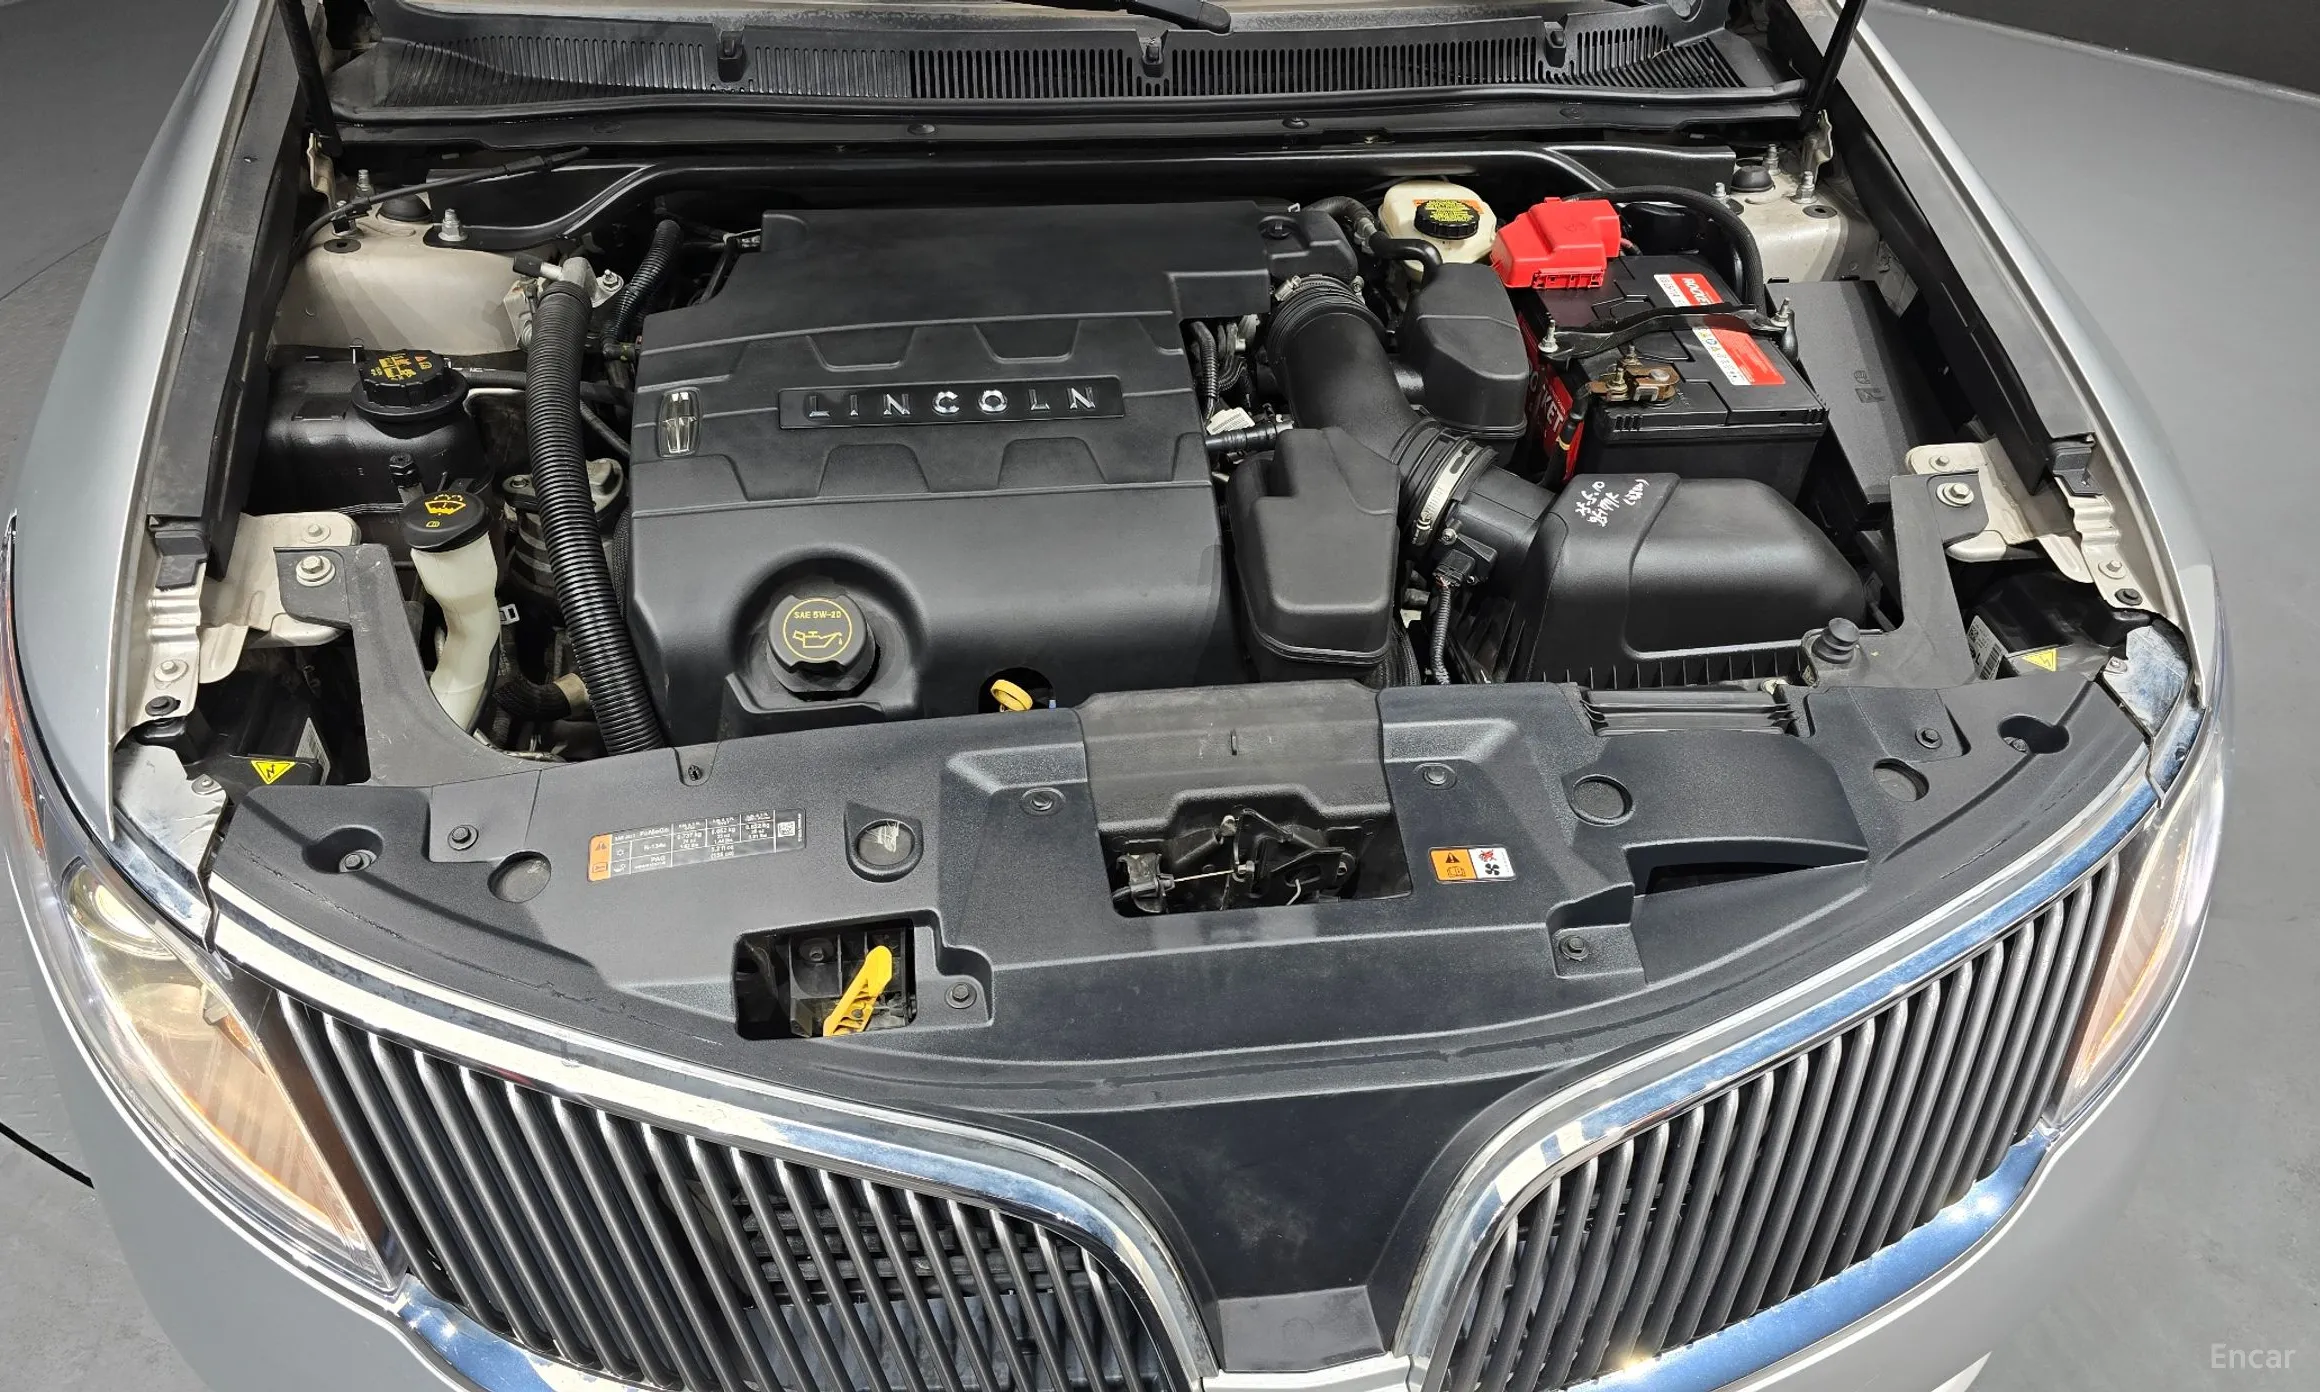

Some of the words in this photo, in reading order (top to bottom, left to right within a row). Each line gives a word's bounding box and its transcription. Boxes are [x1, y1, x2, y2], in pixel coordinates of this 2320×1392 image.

[808, 386, 1096, 417] LINCOLN
[813, 611, 842, 619] 5W-20
[639, 828, 669, 836] FoMoCo
